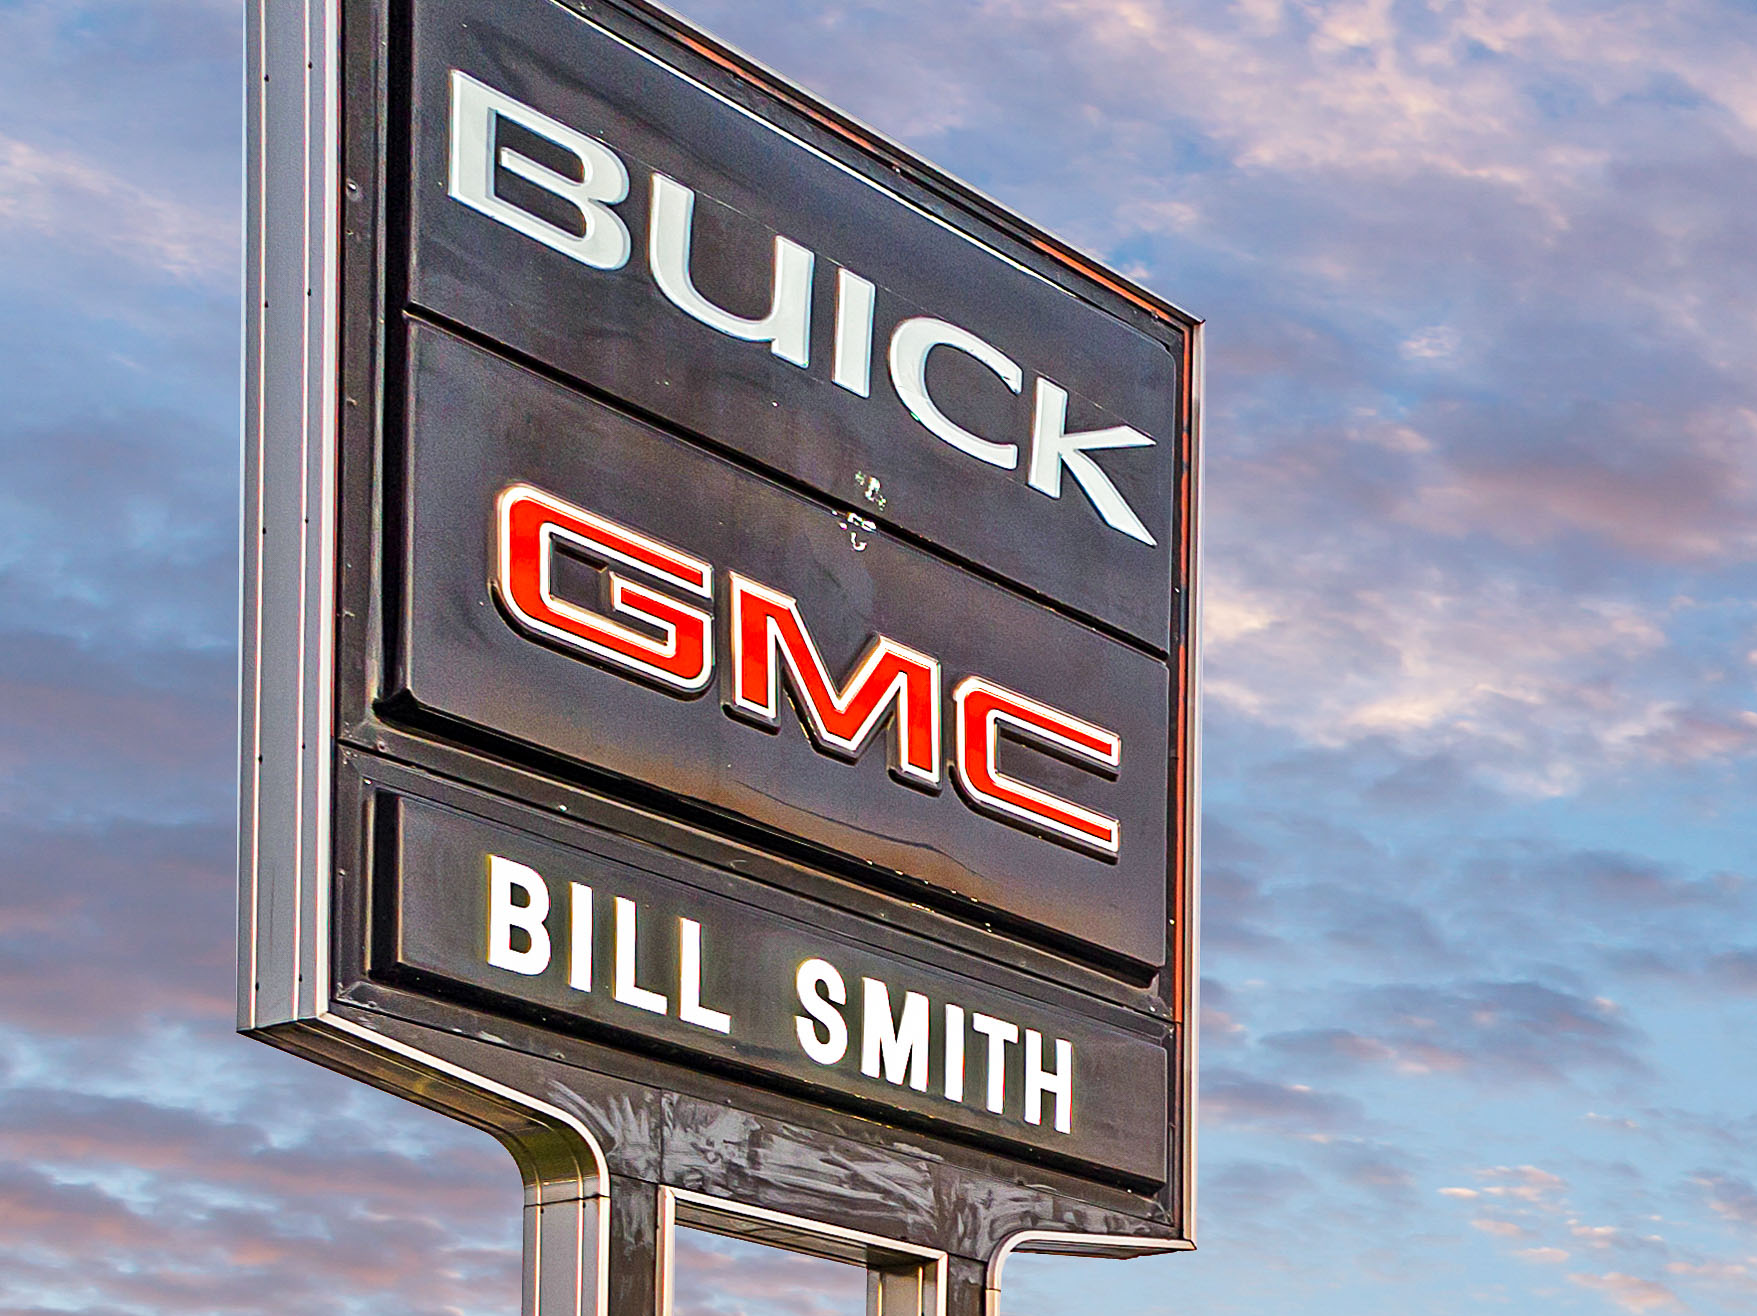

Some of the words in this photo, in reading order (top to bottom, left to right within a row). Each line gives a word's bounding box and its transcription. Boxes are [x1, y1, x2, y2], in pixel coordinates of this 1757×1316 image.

[448, 68, 1158, 548] BUICK
[495, 481, 1121, 860] GMC
[486, 852, 732, 1037] BILL
[794, 956, 1074, 1135] SMITH
